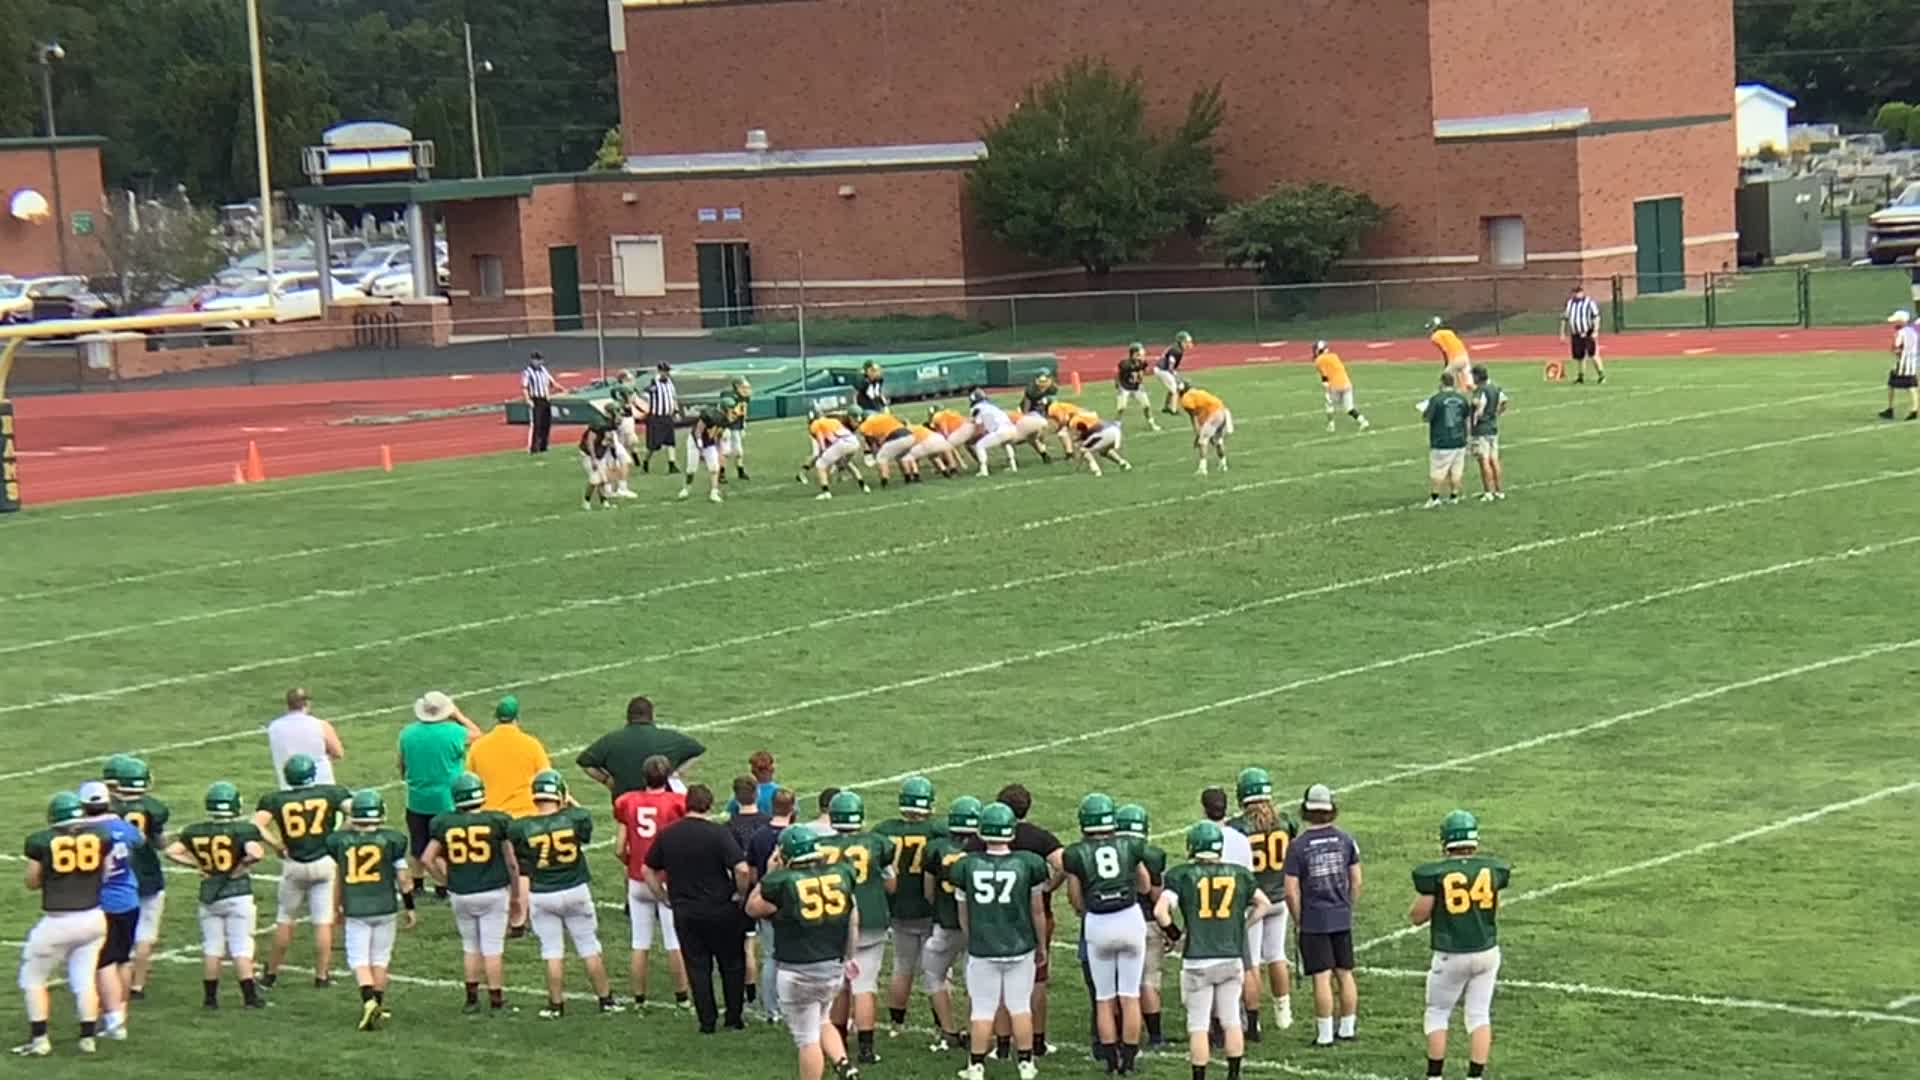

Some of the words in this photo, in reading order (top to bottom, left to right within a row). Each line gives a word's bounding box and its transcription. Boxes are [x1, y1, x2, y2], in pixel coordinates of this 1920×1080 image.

[282, 799, 328, 838] 67
[636, 806, 657, 837] 5
[50, 834, 101, 873] 68
[194, 835, 233, 871] 56
[345, 845, 381, 884] 12
[445, 826, 491, 864] 65
[529, 829, 577, 868] 75
[1094, 846, 1120, 879] 8
[796, 874, 846, 919] 55
[972, 871, 1017, 904] 57
[1196, 876, 1237, 918] 17
[1442, 867, 1494, 914] 64
